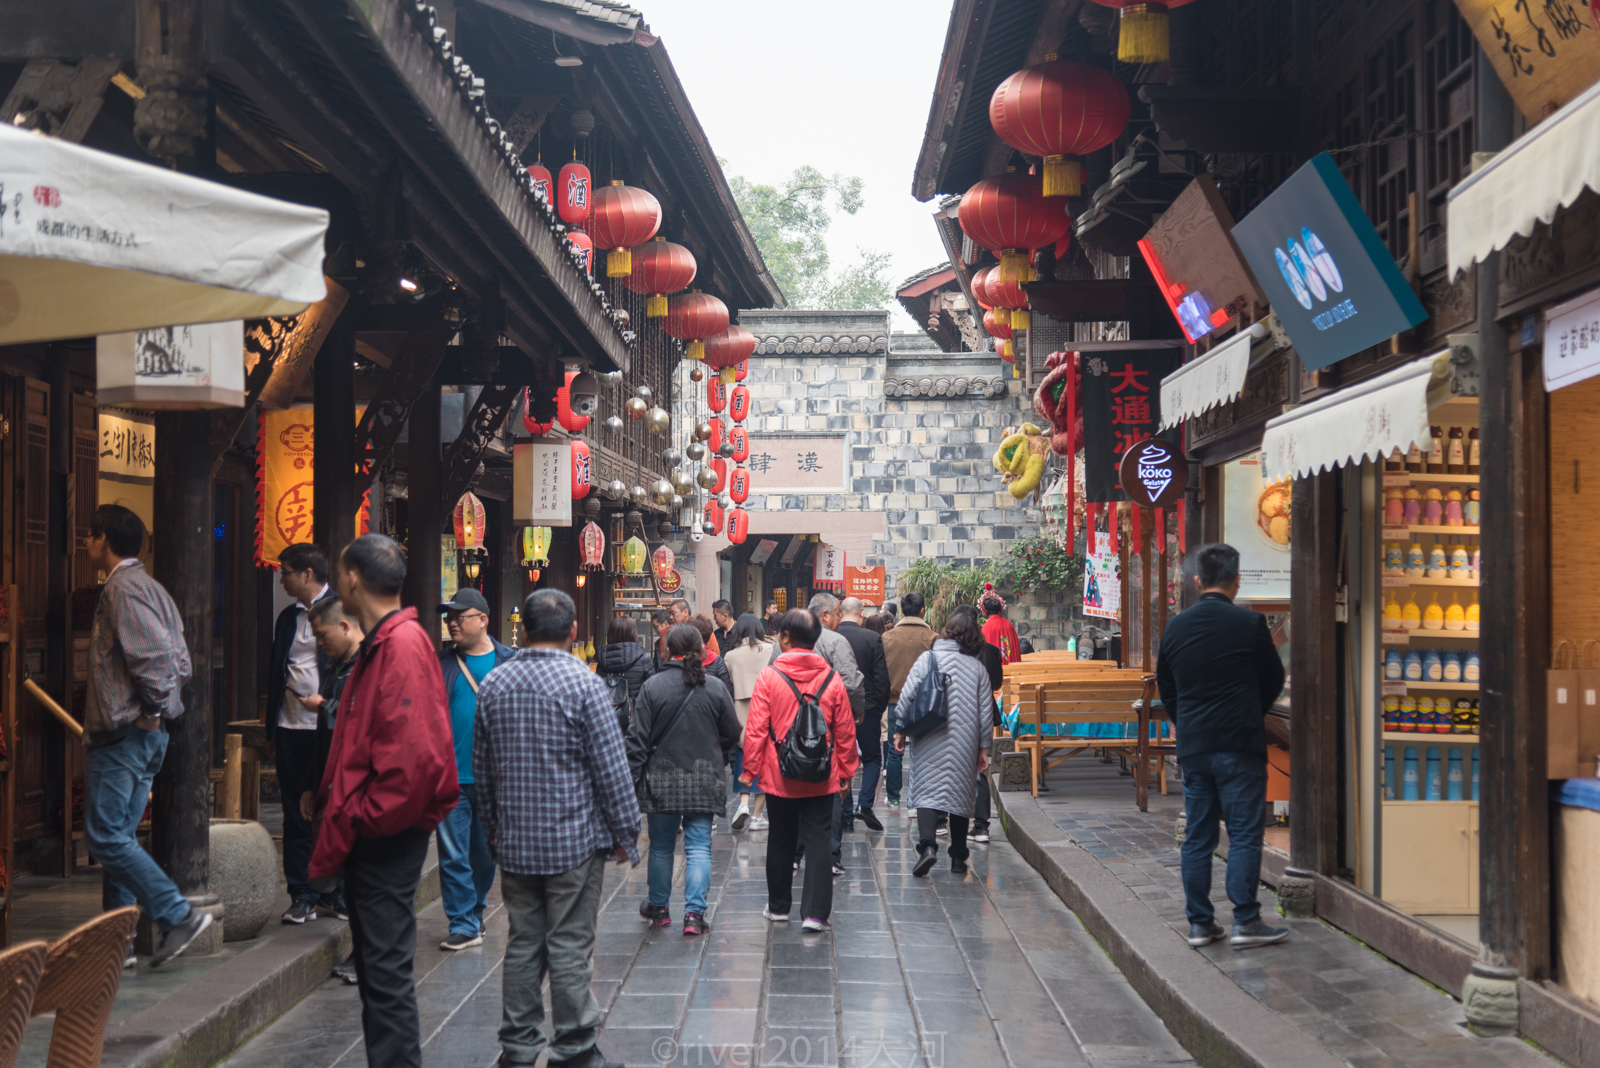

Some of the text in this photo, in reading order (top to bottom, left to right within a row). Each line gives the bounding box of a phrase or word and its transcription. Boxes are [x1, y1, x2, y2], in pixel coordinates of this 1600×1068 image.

[568, 173, 588, 209] 酒
[37, 219, 138, 247] 成都的生活方式
[732, 392, 744, 412] 酒
[1110, 364, 1152, 489] 大通冰
[733, 433, 744, 453] 酒
[733, 475, 745, 496] 酒
